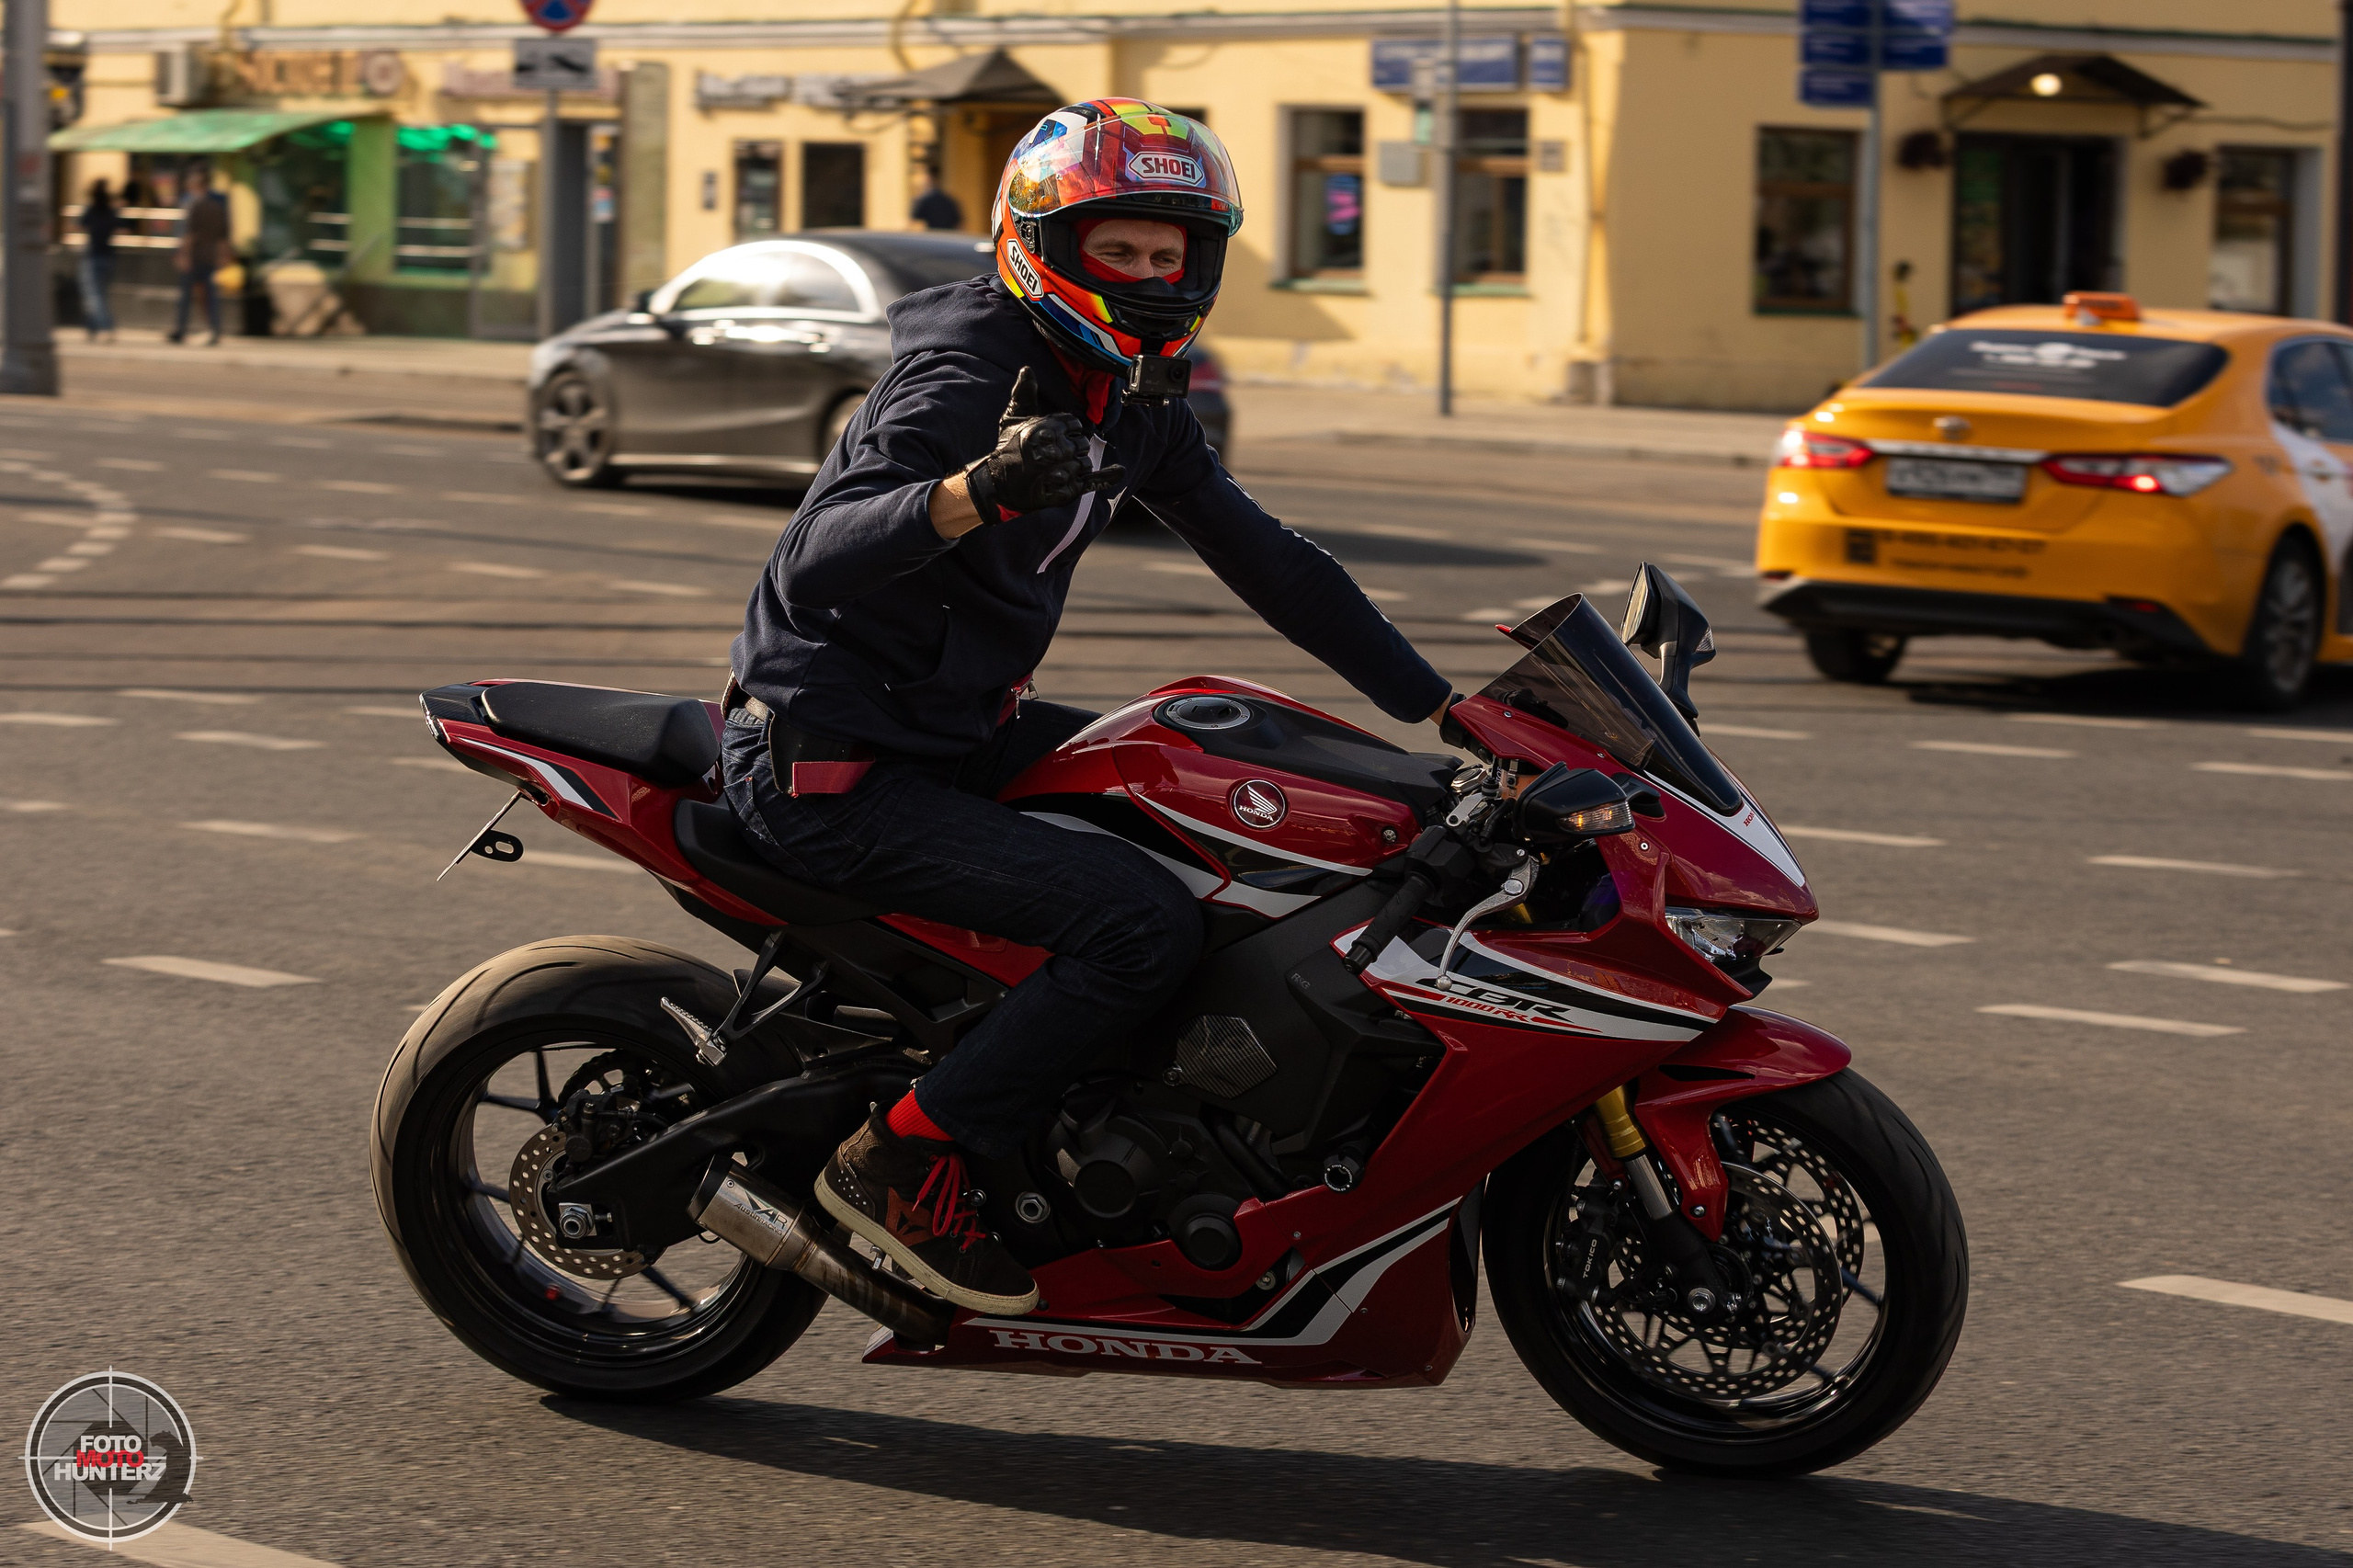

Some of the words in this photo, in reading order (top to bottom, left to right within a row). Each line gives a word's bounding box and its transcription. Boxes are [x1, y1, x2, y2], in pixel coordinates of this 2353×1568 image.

[1142, 157, 1195, 180] SHOEI
[1009, 245, 1039, 294] SHOEI
[1239, 805, 1274, 822] HONDA
[1445, 996, 1530, 1023] 1000RR
[1582, 1238, 1598, 1279] TOKICO
[989, 1330, 1263, 1365] HONDA
